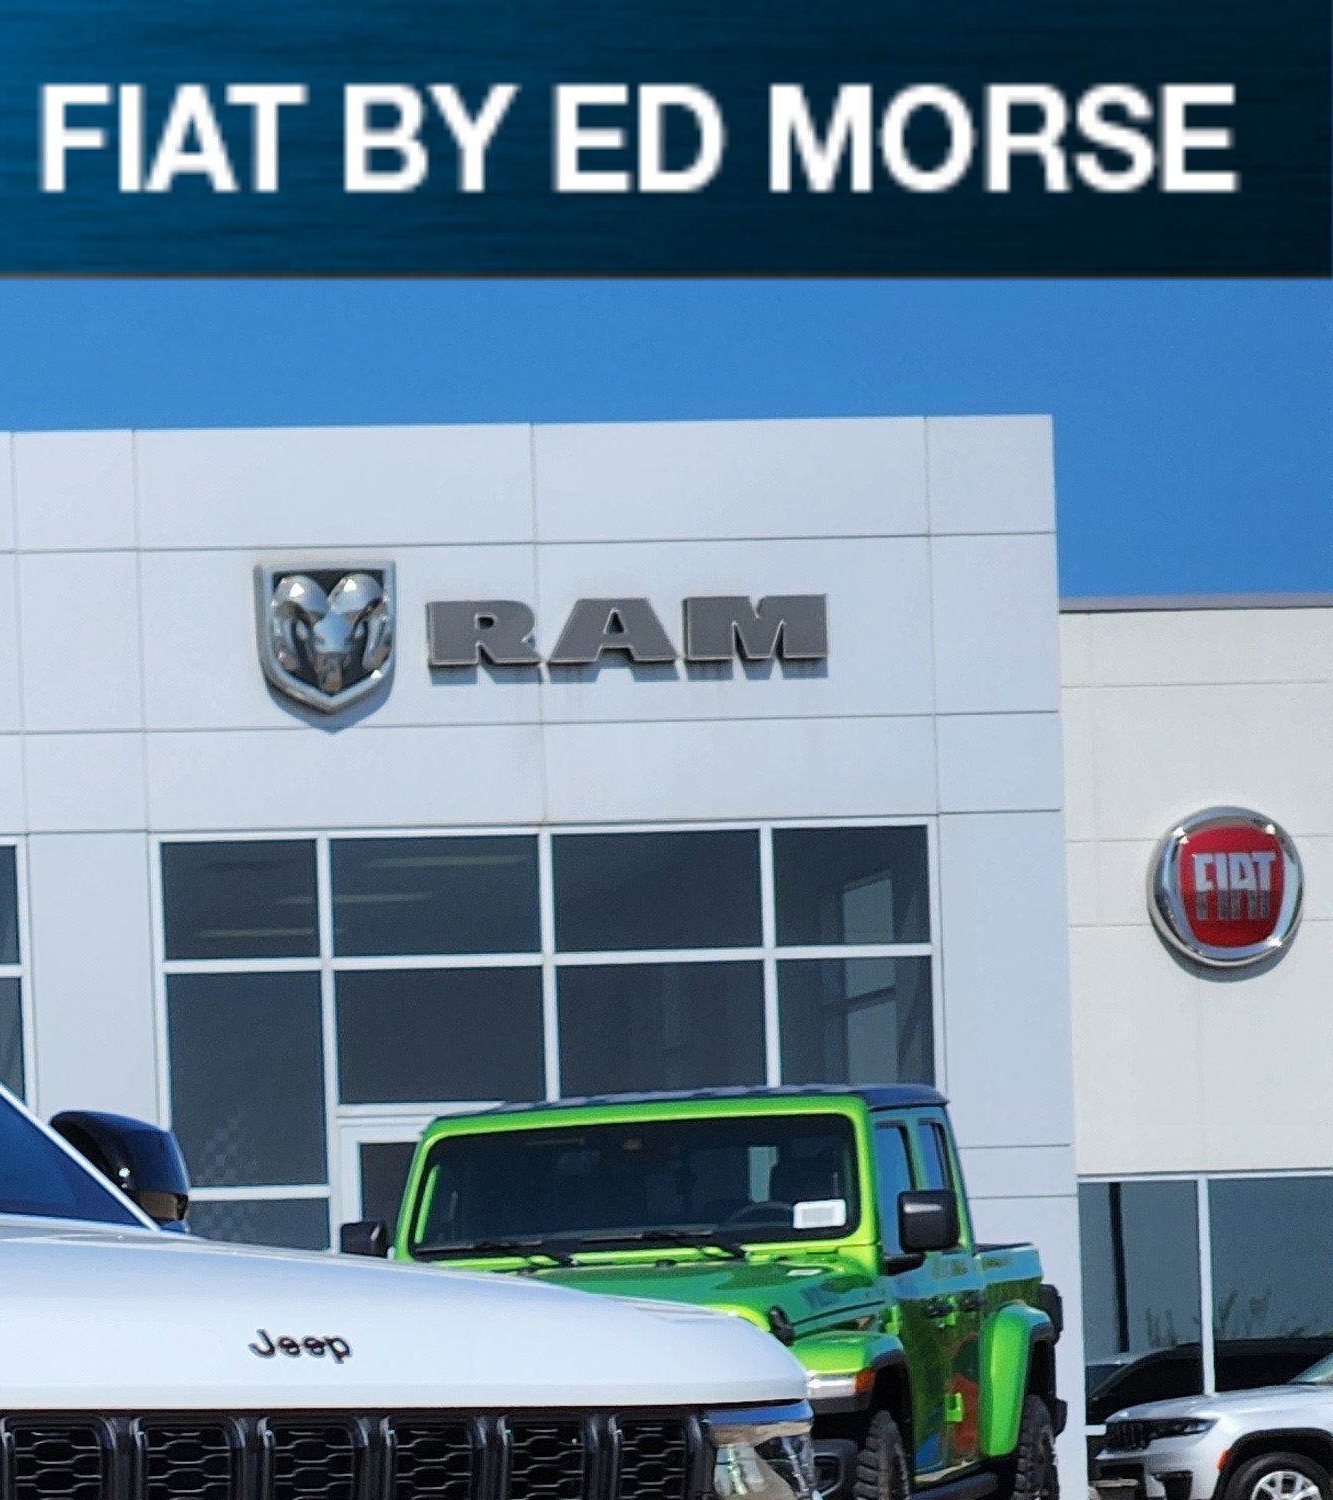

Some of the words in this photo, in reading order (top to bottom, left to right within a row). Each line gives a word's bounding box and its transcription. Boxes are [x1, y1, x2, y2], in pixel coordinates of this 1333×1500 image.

[425, 592, 829, 668] RAM
[1191, 851, 1277, 922] FIAT
[248, 1328, 353, 1364] Jeep
